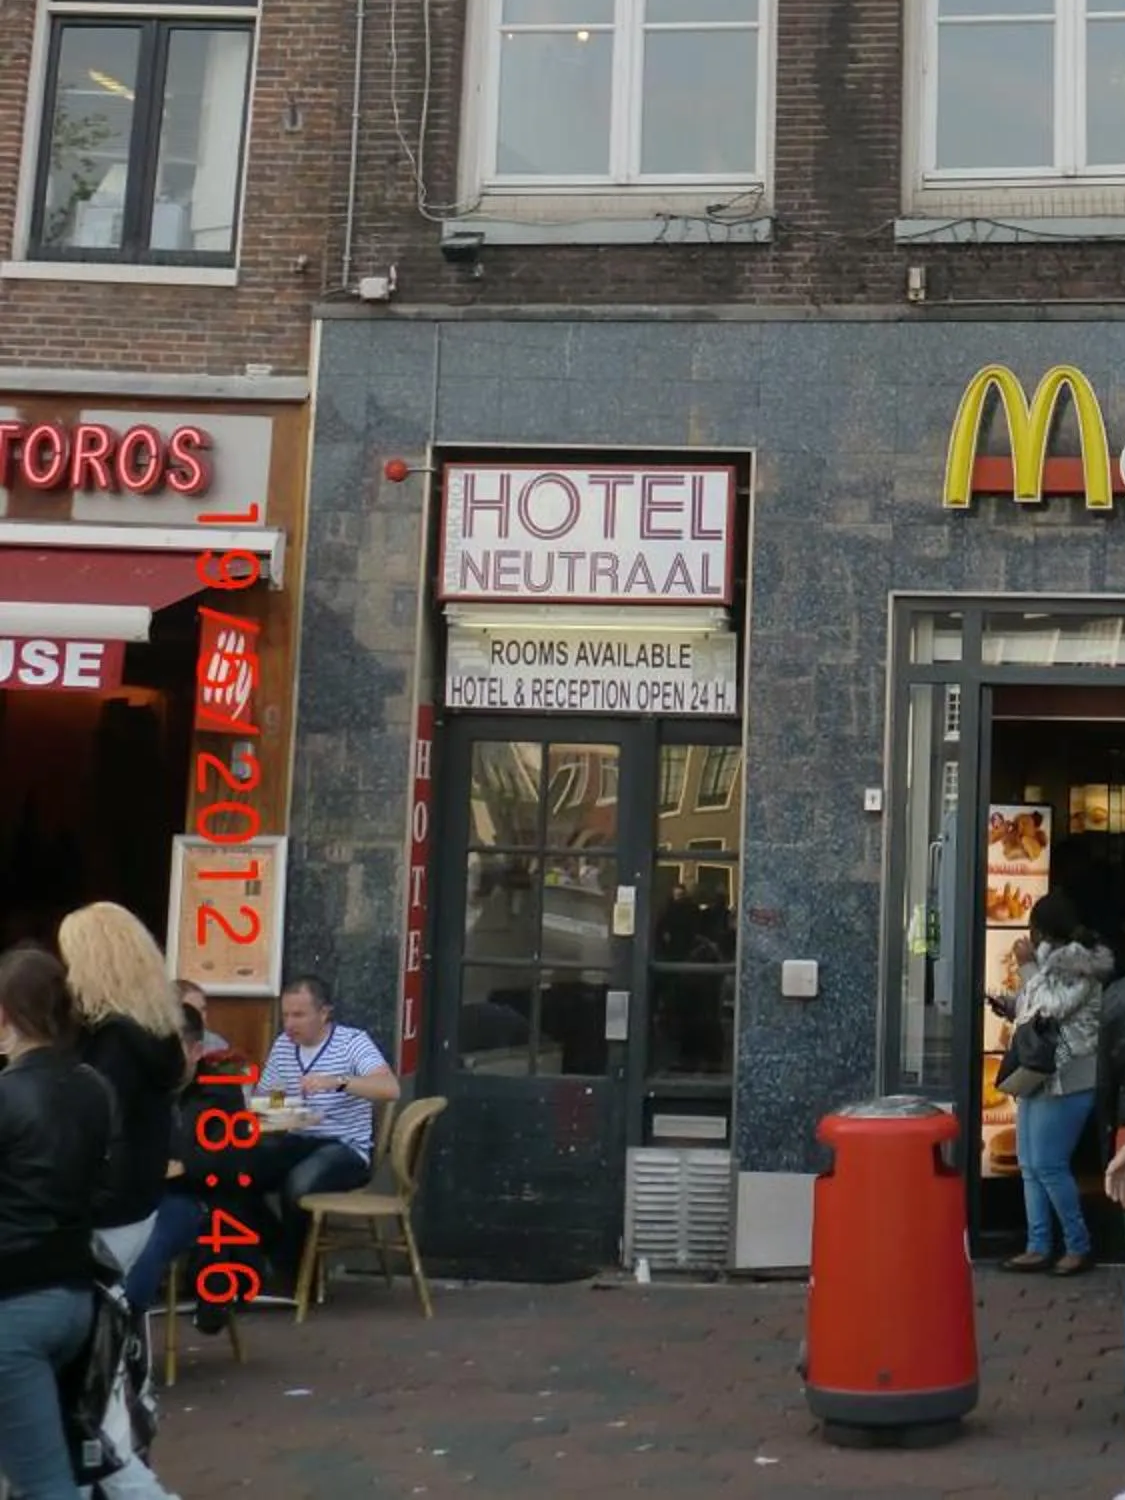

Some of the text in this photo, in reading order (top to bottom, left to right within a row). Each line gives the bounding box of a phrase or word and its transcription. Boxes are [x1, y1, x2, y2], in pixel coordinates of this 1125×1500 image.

[461, 472, 723, 541] HOTEL
[459, 549, 722, 594] NEUTRAAL
[490, 640, 692, 669] ROOMS AVAILABLE
[451, 675, 731, 713] HOTEL & RECEPTION OPEN 24 H.
[404, 738, 434, 1041] HOTEL
